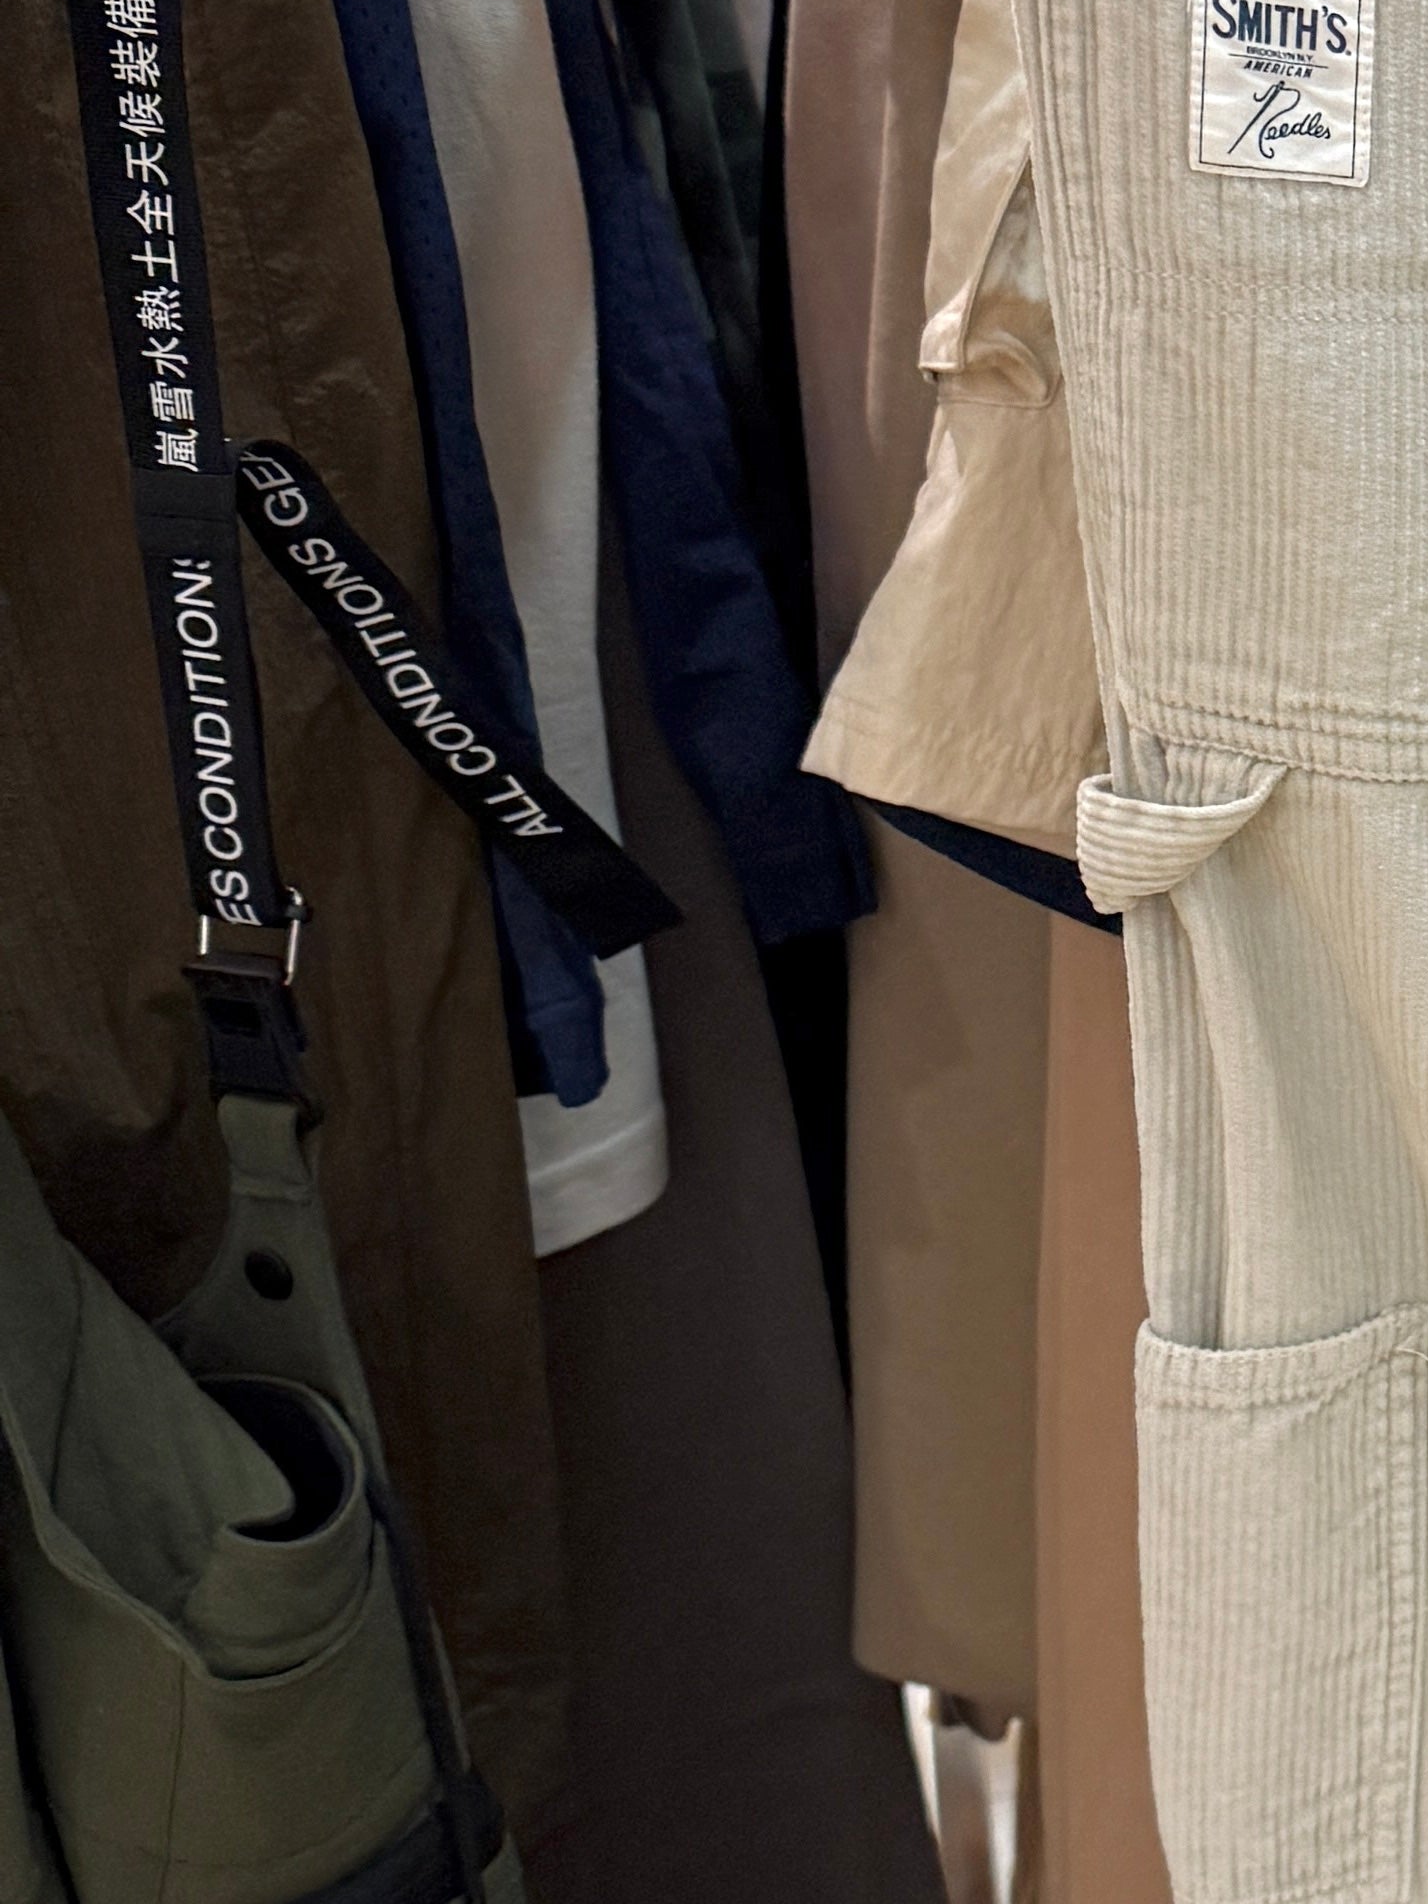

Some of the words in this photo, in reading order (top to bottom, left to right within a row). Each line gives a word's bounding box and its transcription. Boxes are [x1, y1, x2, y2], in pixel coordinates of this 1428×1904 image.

[1243, 60, 1313, 79] AMERICAN
[1226, 80, 1332, 160] Needles
[288, 538, 496, 776] CONDITIONS
[483, 773, 563, 837] ALL
